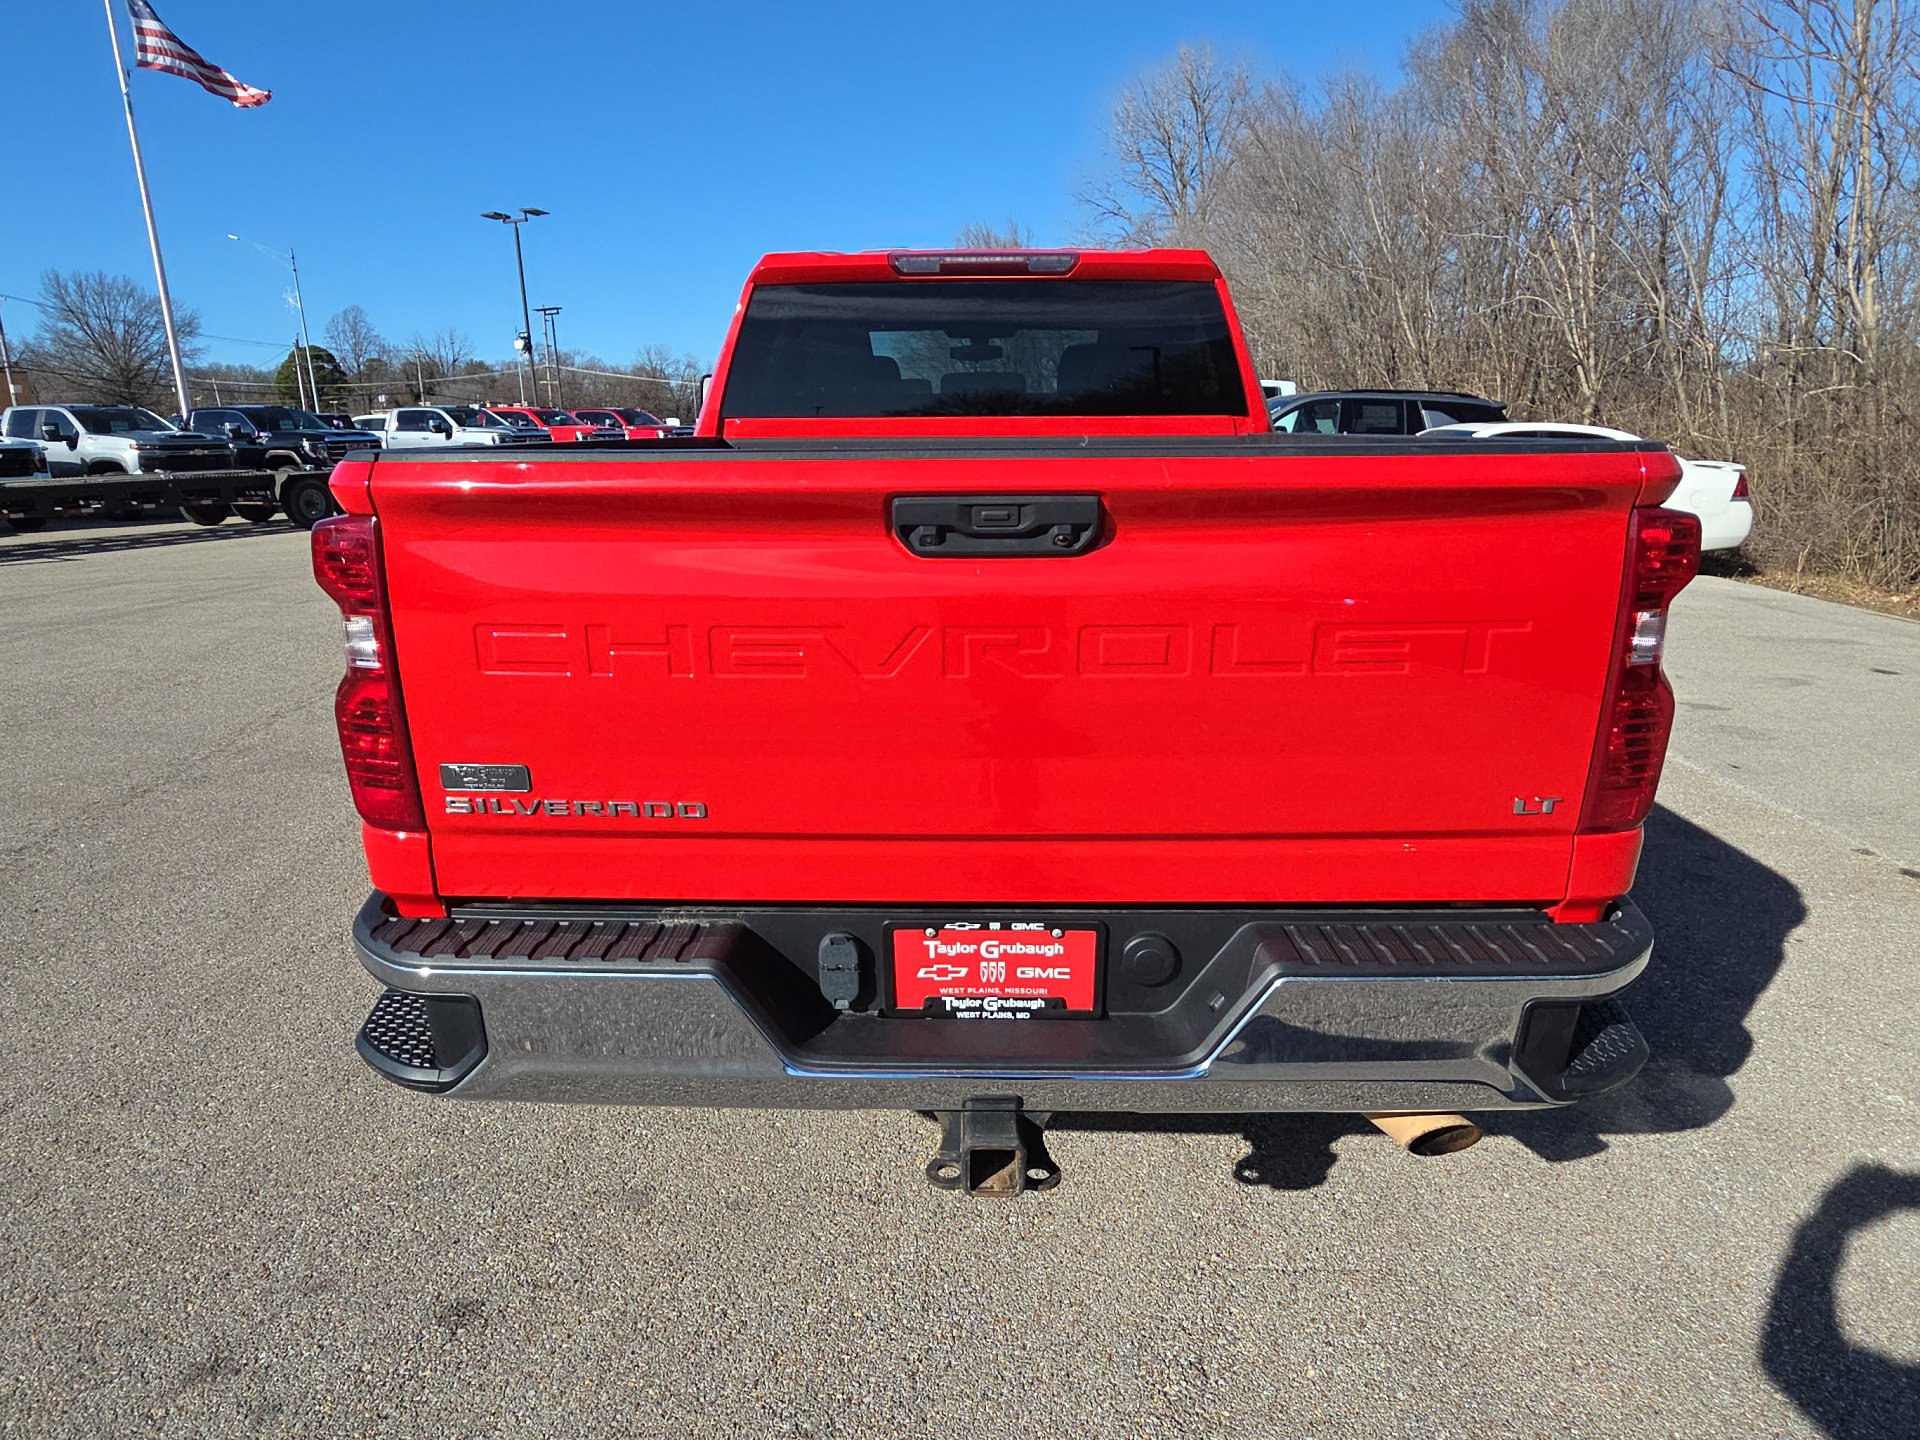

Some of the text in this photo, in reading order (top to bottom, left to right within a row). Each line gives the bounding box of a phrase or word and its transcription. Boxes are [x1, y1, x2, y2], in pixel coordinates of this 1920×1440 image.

[473, 620, 1532, 680] CHEVROLET
[445, 796, 708, 818] SILVERADO
[1514, 796, 1563, 815] LT
[1011, 922, 1045, 931] GMC
[923, 940, 1064, 959] Taylor Grubaugh
[1016, 967, 1071, 979] GMC
[939, 987, 1048, 995] WEST PLAINS, MISSOURI
[941, 996, 1046, 1011] Taylor Grubaugh
[956, 1011, 980, 1019] WEST
[982, 1011, 1014, 1020] PLAINS,
